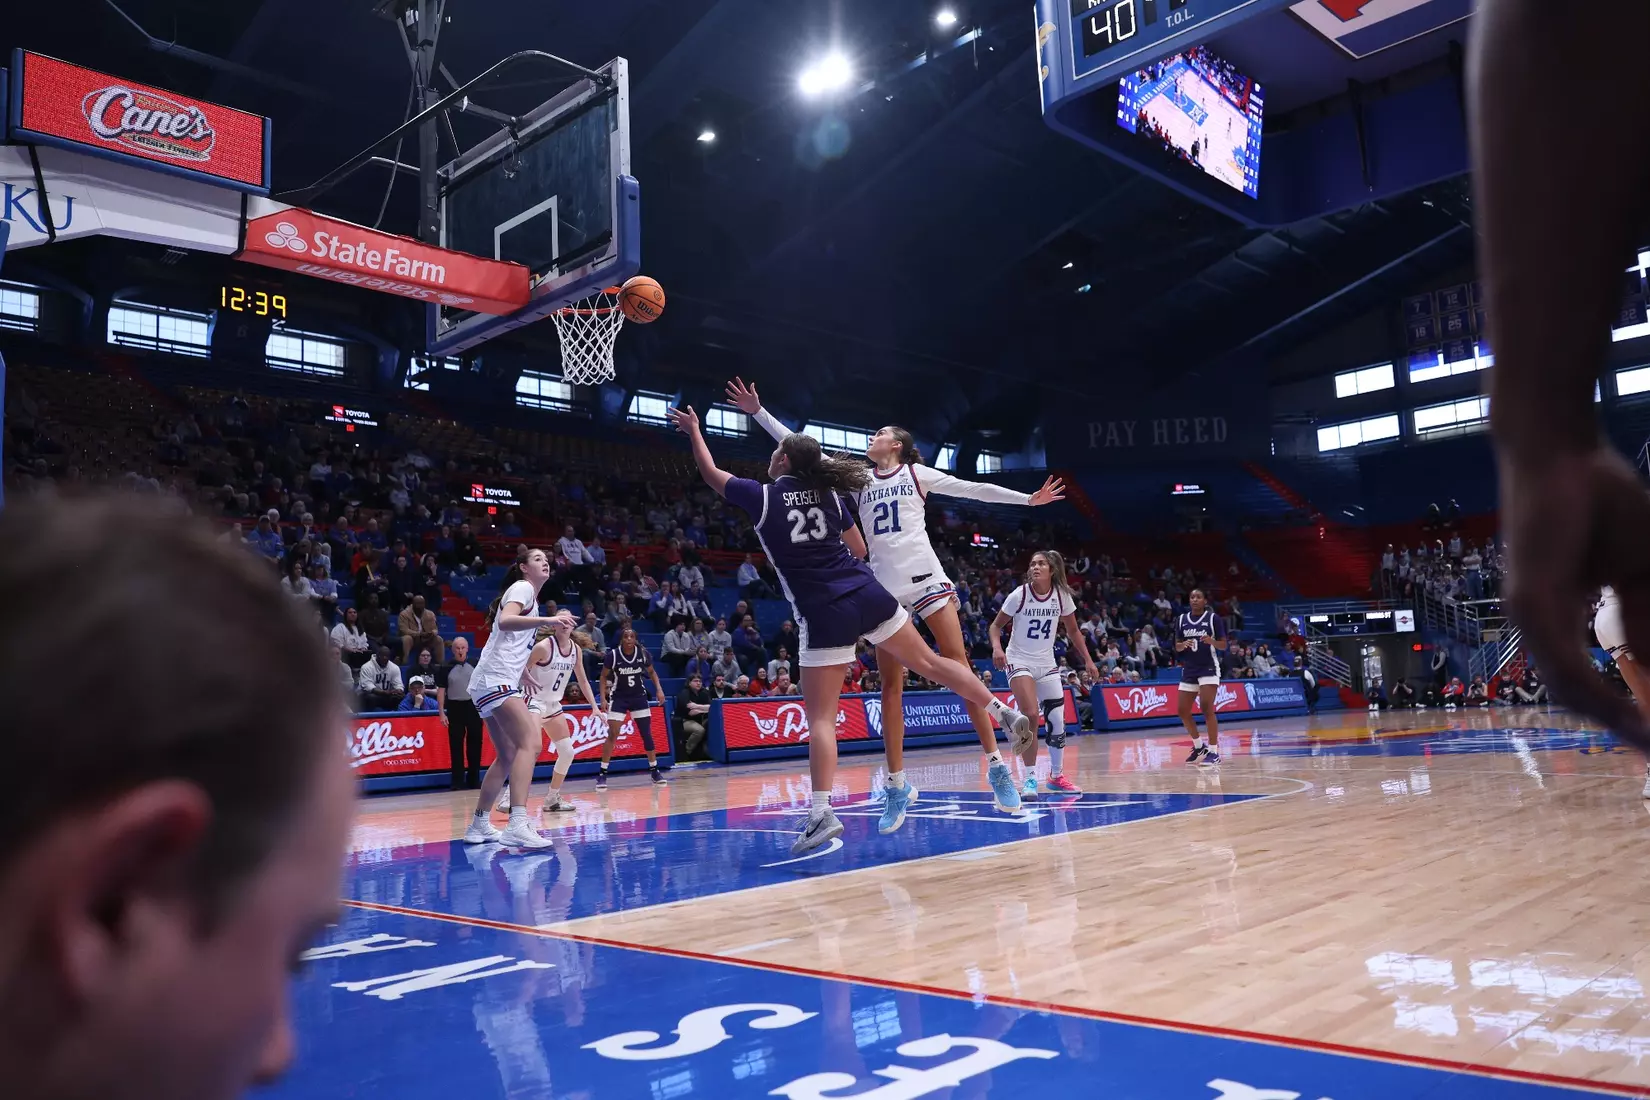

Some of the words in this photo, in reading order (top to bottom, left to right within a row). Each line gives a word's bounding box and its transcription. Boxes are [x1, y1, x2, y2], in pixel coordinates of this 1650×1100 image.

[1165, 8, 1195, 28] T.O.L.
[89, 86, 213, 141] Cane's
[221, 286, 287, 319] 12:39
[345, 408, 370, 419] TOYOTA
[1088, 420, 1137, 450] PAY
[1151, 416, 1229, 446] HEED
[485, 487, 512, 498] TOYOTA
[783, 490, 821, 506] SPEISER
[863, 484, 914, 504] JAYHAWKS
[786, 507, 828, 543] 23
[873, 500, 902, 535] 21
[1023, 608, 1060, 616] JAYHAWKS
[1027, 619, 1052, 640] 24
[552, 672, 564, 691] 6
[627, 675, 636, 688] 5
[1128, 687, 1168, 715] Dillons
[1213, 684, 1238, 706] illons
[905, 704, 951, 716] UNIVERSITY
[951, 703, 961, 714] OF
[920, 715, 950, 727] HEALTH
[950, 714, 973, 724] SYSTE
[345, 721, 425, 758] illons
